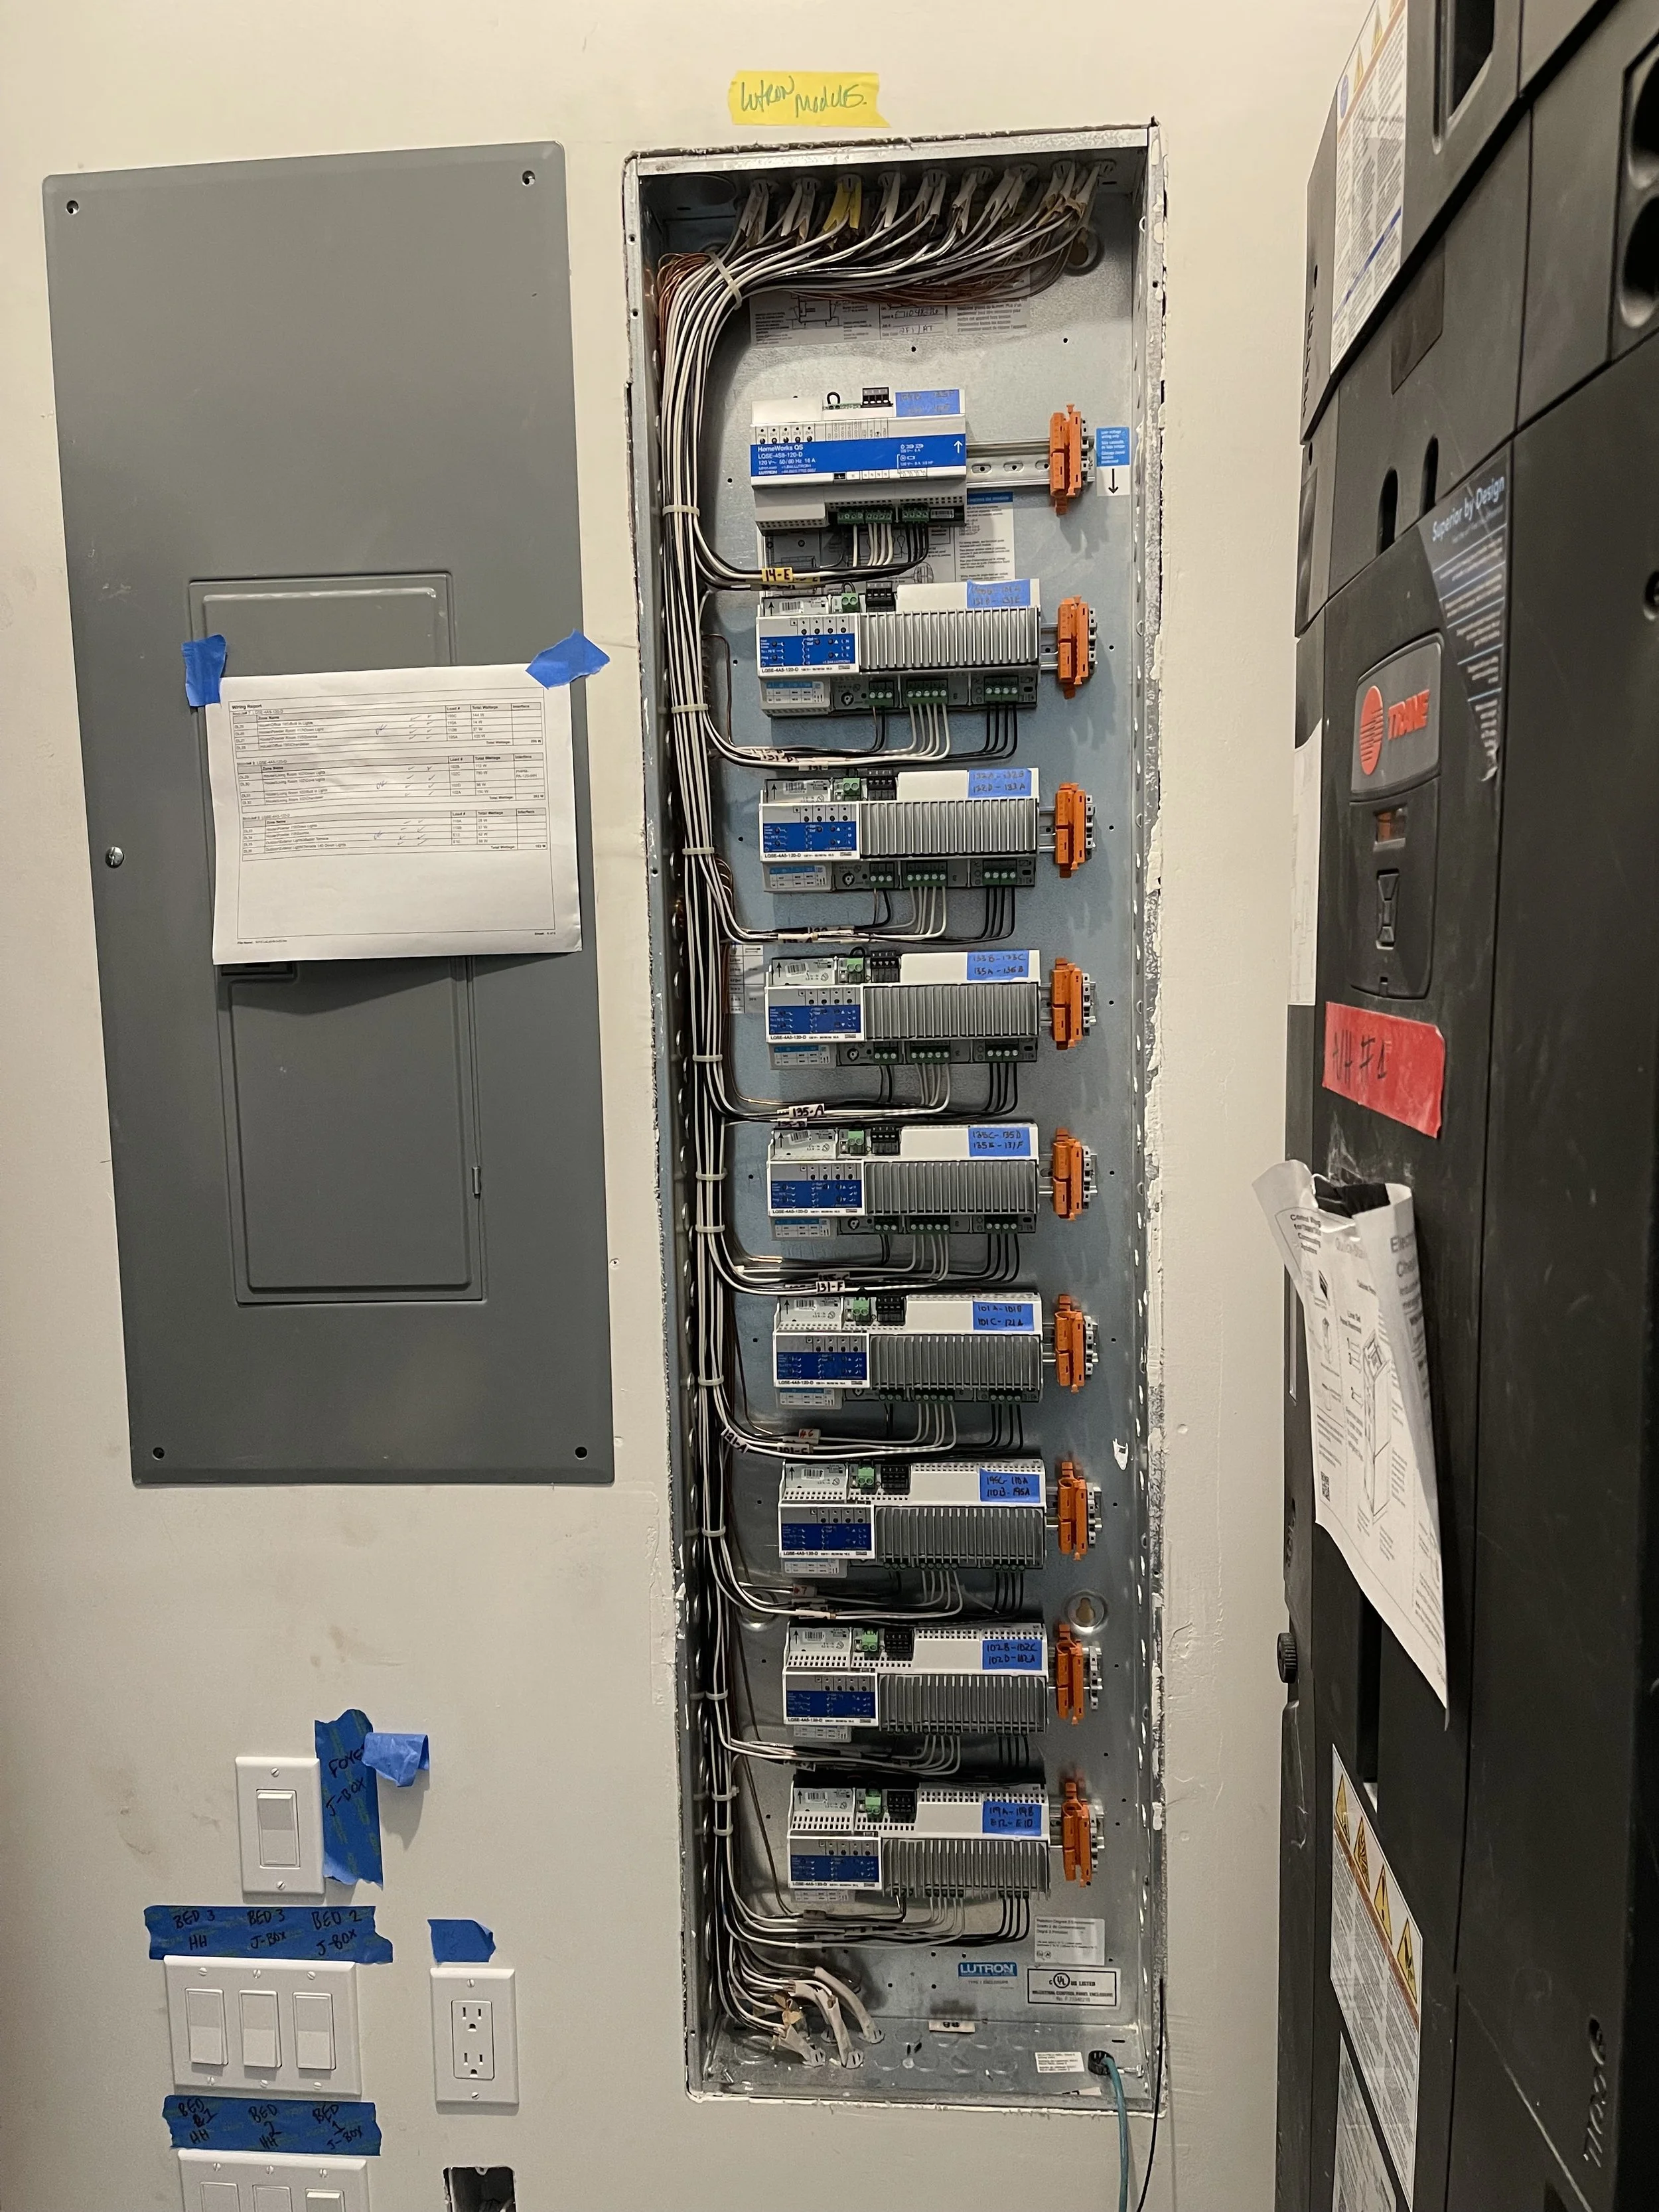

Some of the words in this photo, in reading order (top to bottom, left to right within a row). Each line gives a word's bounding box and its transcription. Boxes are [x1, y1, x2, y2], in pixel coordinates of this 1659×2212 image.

[1433, 508, 1463, 542] Superior
[1464, 497, 1474, 521] by
[1475, 477, 1504, 510] Design
[765, 569, 790, 581] 14-E
[1388, 688, 1430, 741] TRANE
[792, 1104, 824, 1117] 135-A
[817, 1282, 843, 1292] 131-F
[325, 1777, 366, 1817] J-BOX
[173, 1910, 200, 1930] BED
[207, 1909, 216, 1922] 3
[247, 1910, 271, 1926] BED
[277, 1909, 286, 1922] 3
[311, 1910, 342, 1931] BED
[349, 1909, 363, 1923] 2
[250, 1931, 287, 1950] J-BOX
[316, 1928, 357, 1956] J-BOX
[960, 1964, 1014, 1974] LUTRON
[178, 2099, 205, 2117] BED
[312, 2104, 340, 2124] BED
[248, 2104, 278, 2124] BED
[264, 2120, 283, 2136] 2
[326, 2125, 364, 2150] J-BOX
